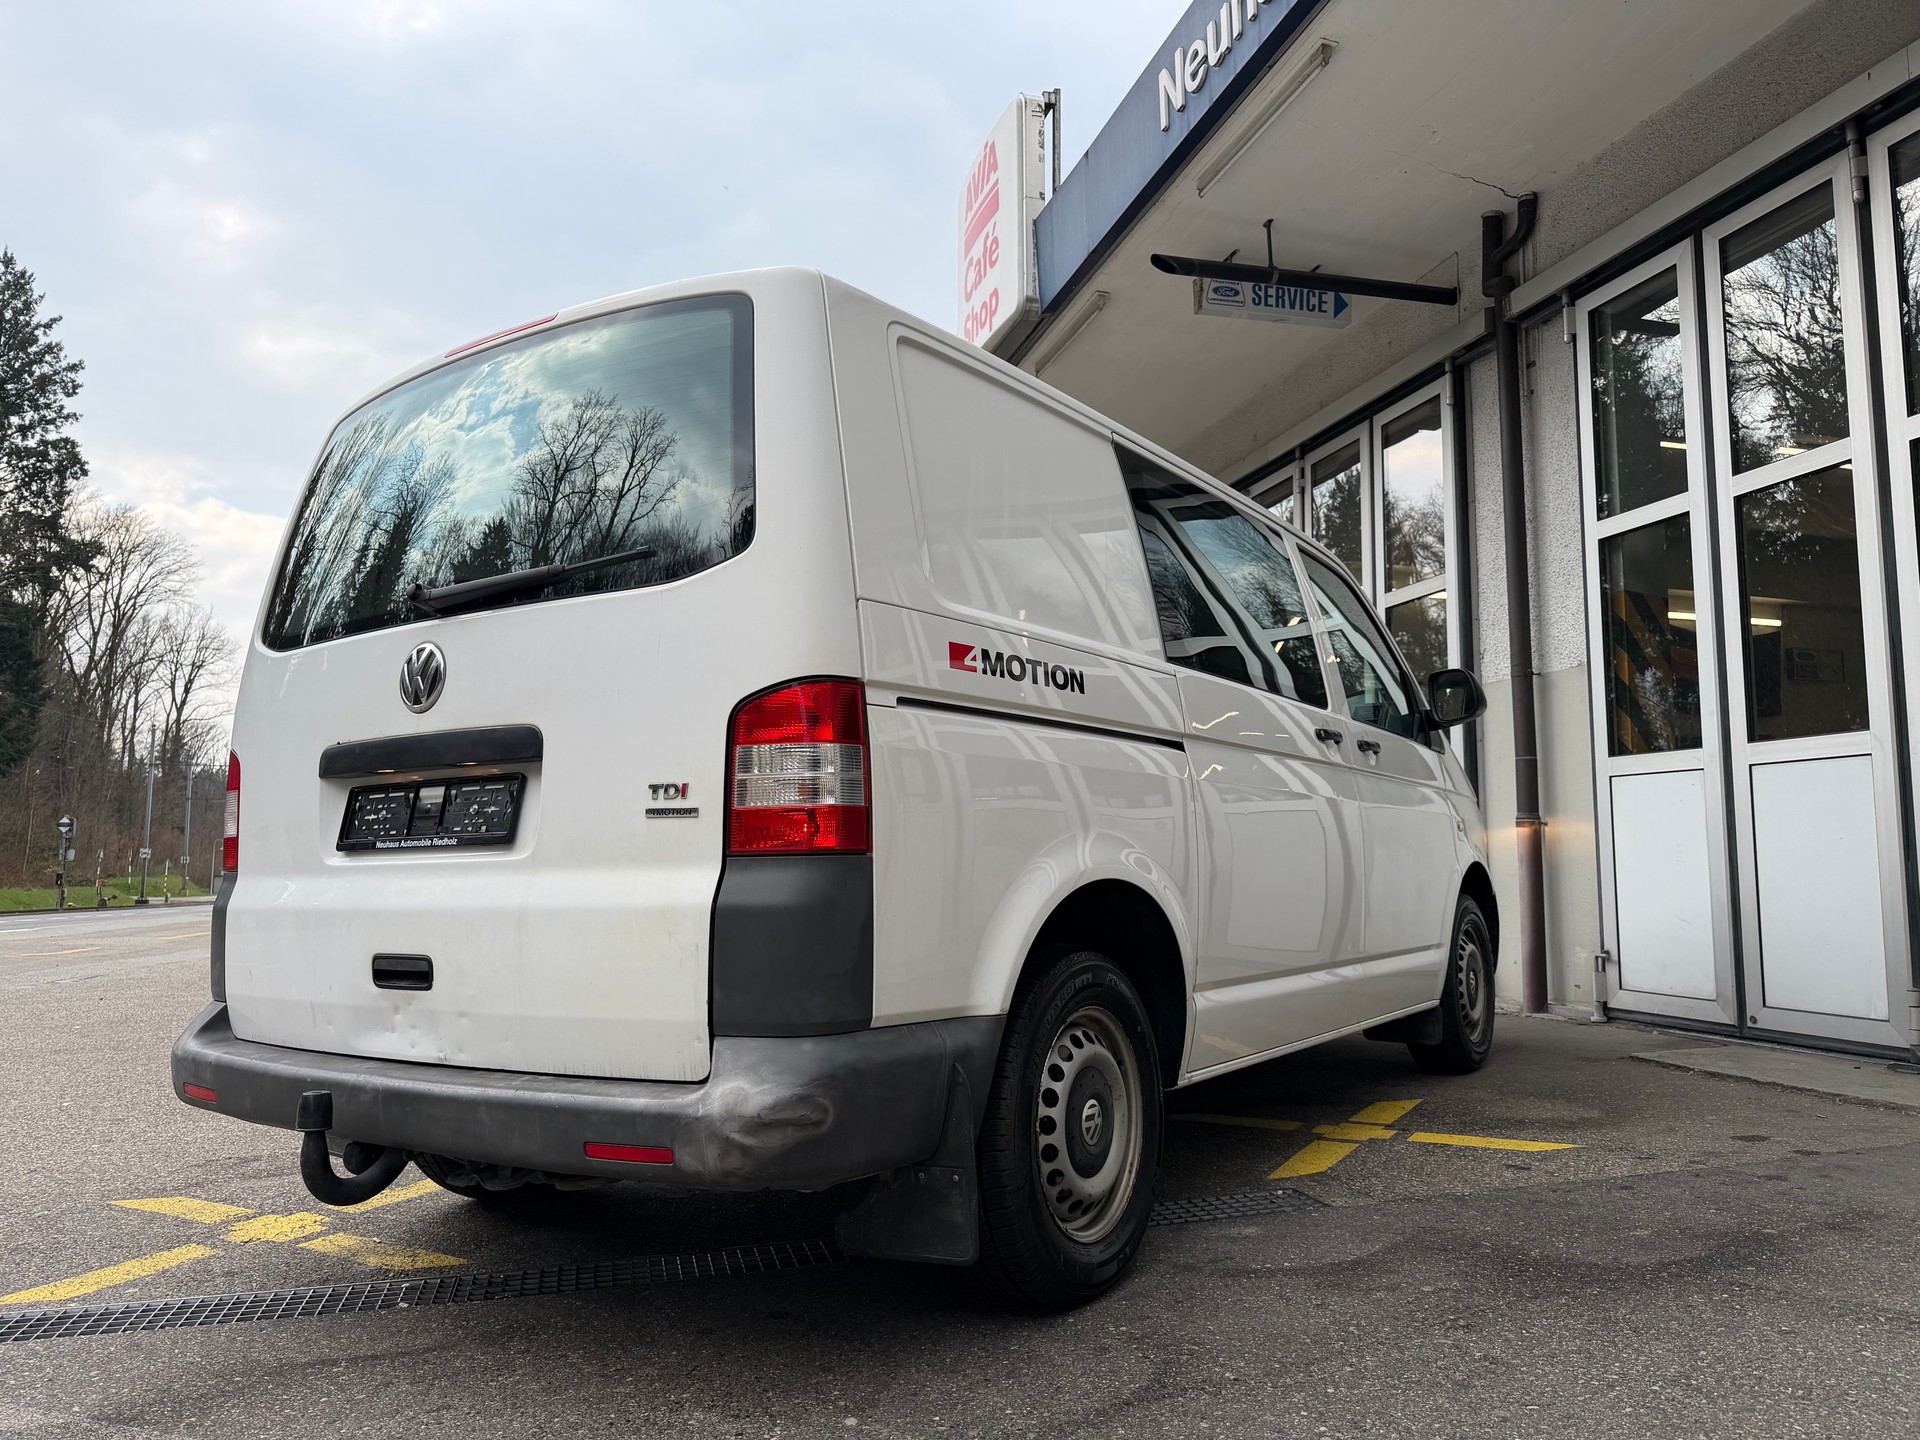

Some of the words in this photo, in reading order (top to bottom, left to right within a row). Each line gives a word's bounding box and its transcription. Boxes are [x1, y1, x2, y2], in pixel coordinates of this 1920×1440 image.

[965, 139, 999, 222] AVIA
[964, 220, 1000, 304] Café
[964, 287, 999, 343] Shop
[1252, 283, 1328, 313] SERVICE
[949, 641, 1086, 695] 4MOTION
[648, 782, 689, 801] TDI
[375, 840, 399, 849] Neuhaus
[400, 838, 432, 848] Automobile
[432, 836, 458, 846] Riedholz
